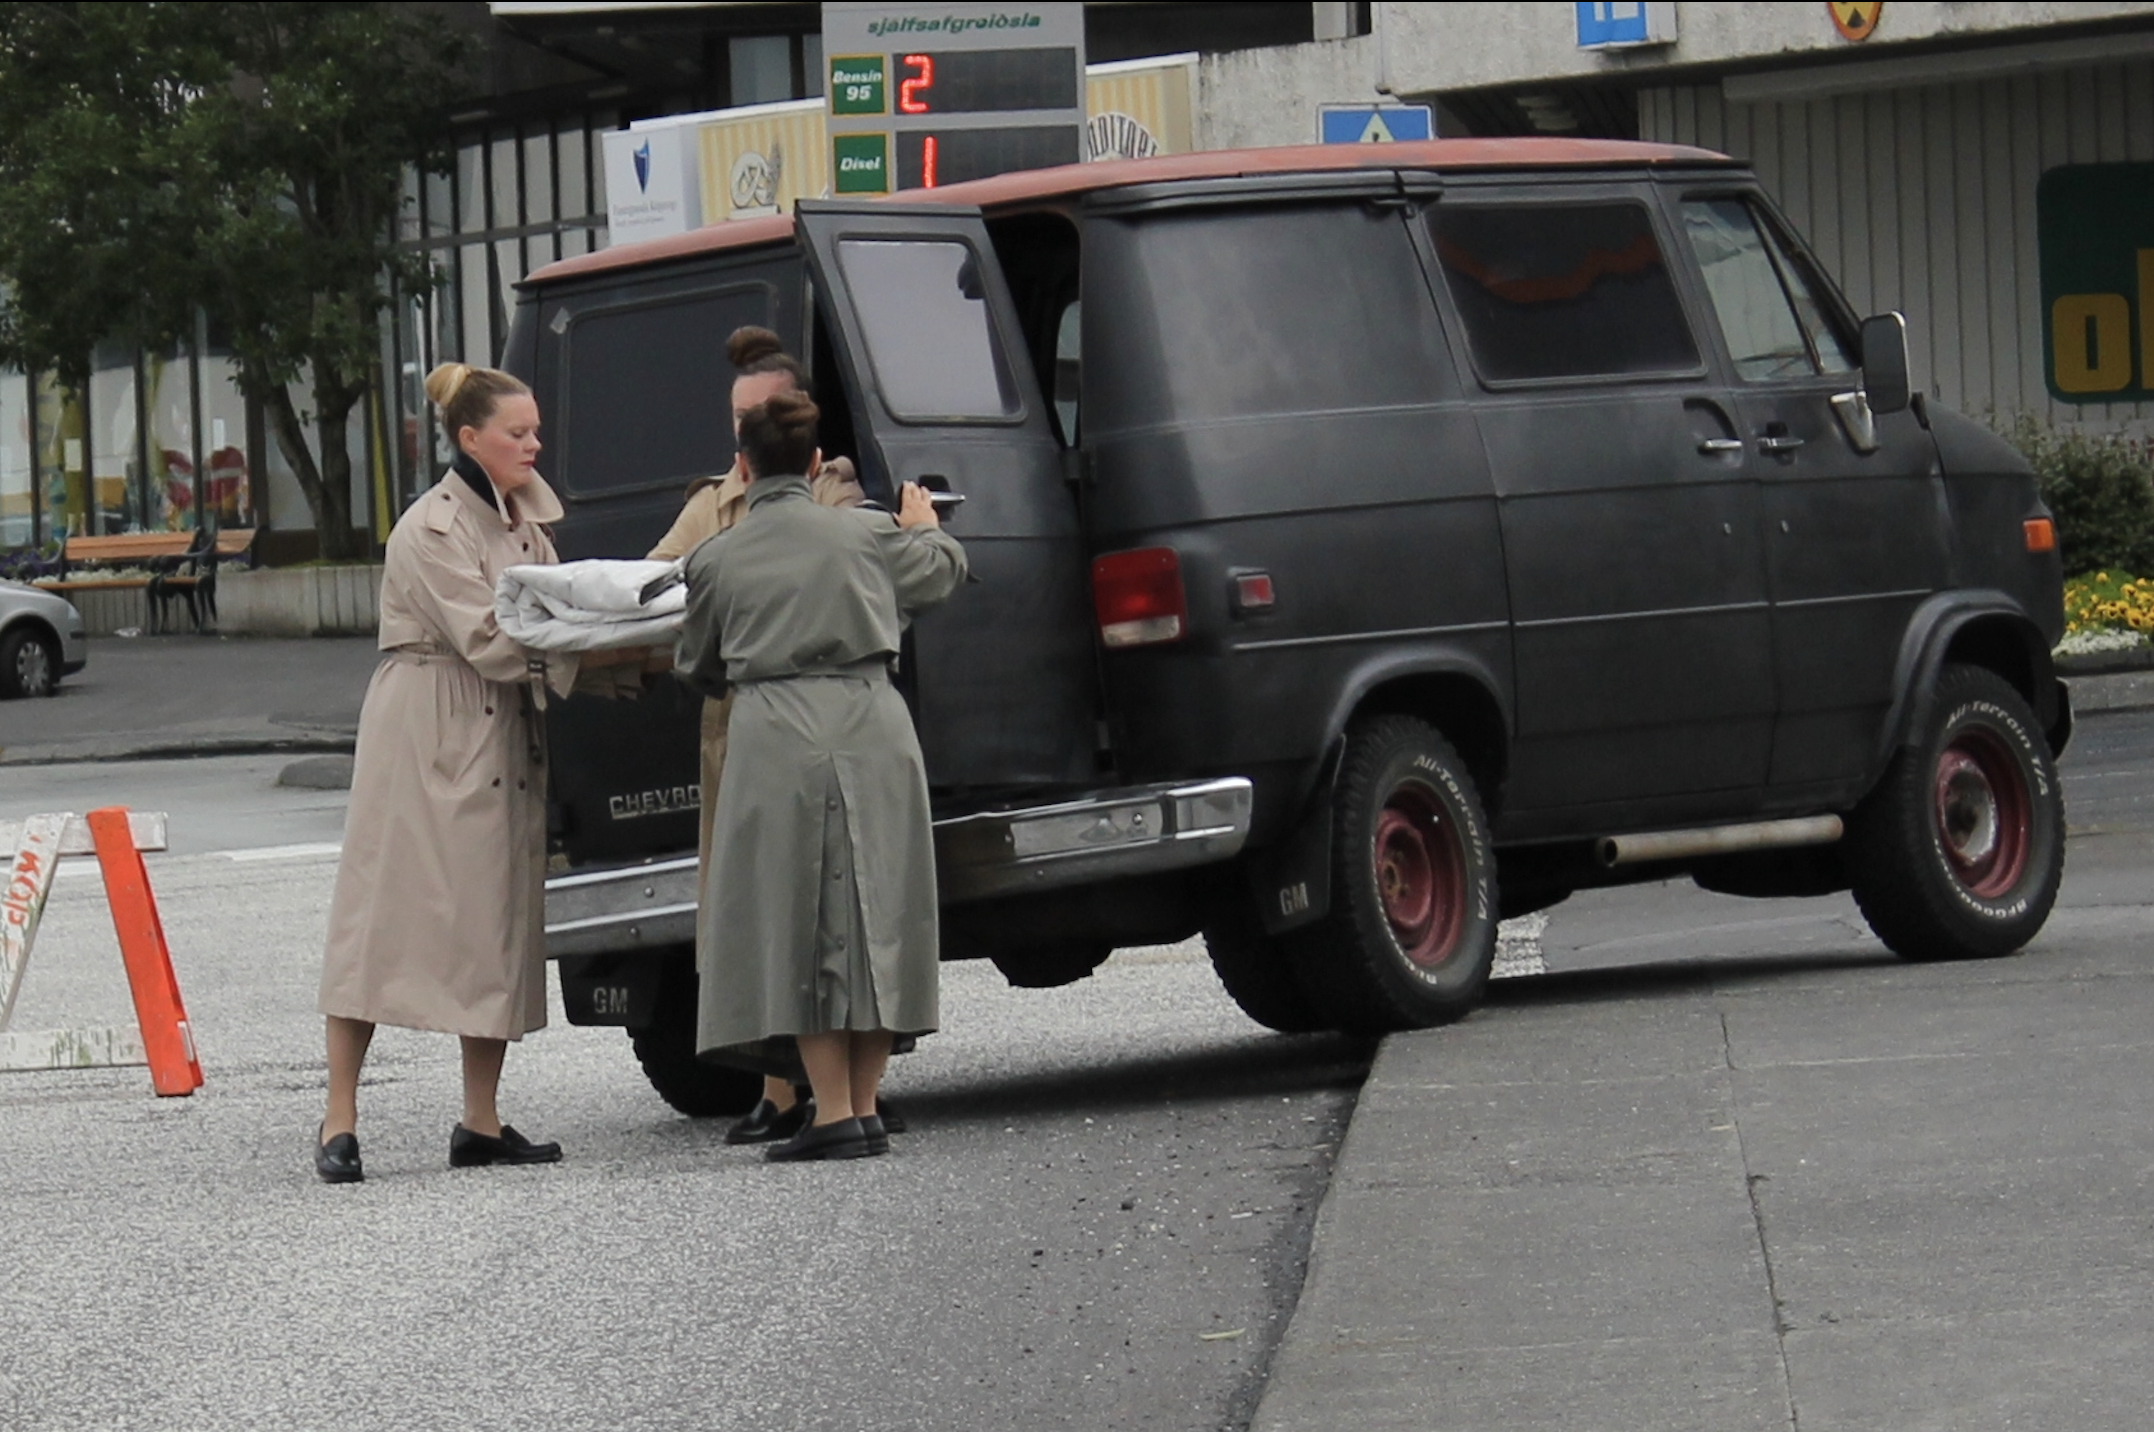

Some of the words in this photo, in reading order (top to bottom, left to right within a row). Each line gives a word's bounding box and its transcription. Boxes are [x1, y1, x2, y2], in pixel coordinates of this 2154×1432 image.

[846, 85, 871, 101] 95
[900, 54, 934, 113] 2
[924, 136, 937, 188] 1
[1279, 882, 1309, 916] GM
[593, 987, 629, 1015] GM
